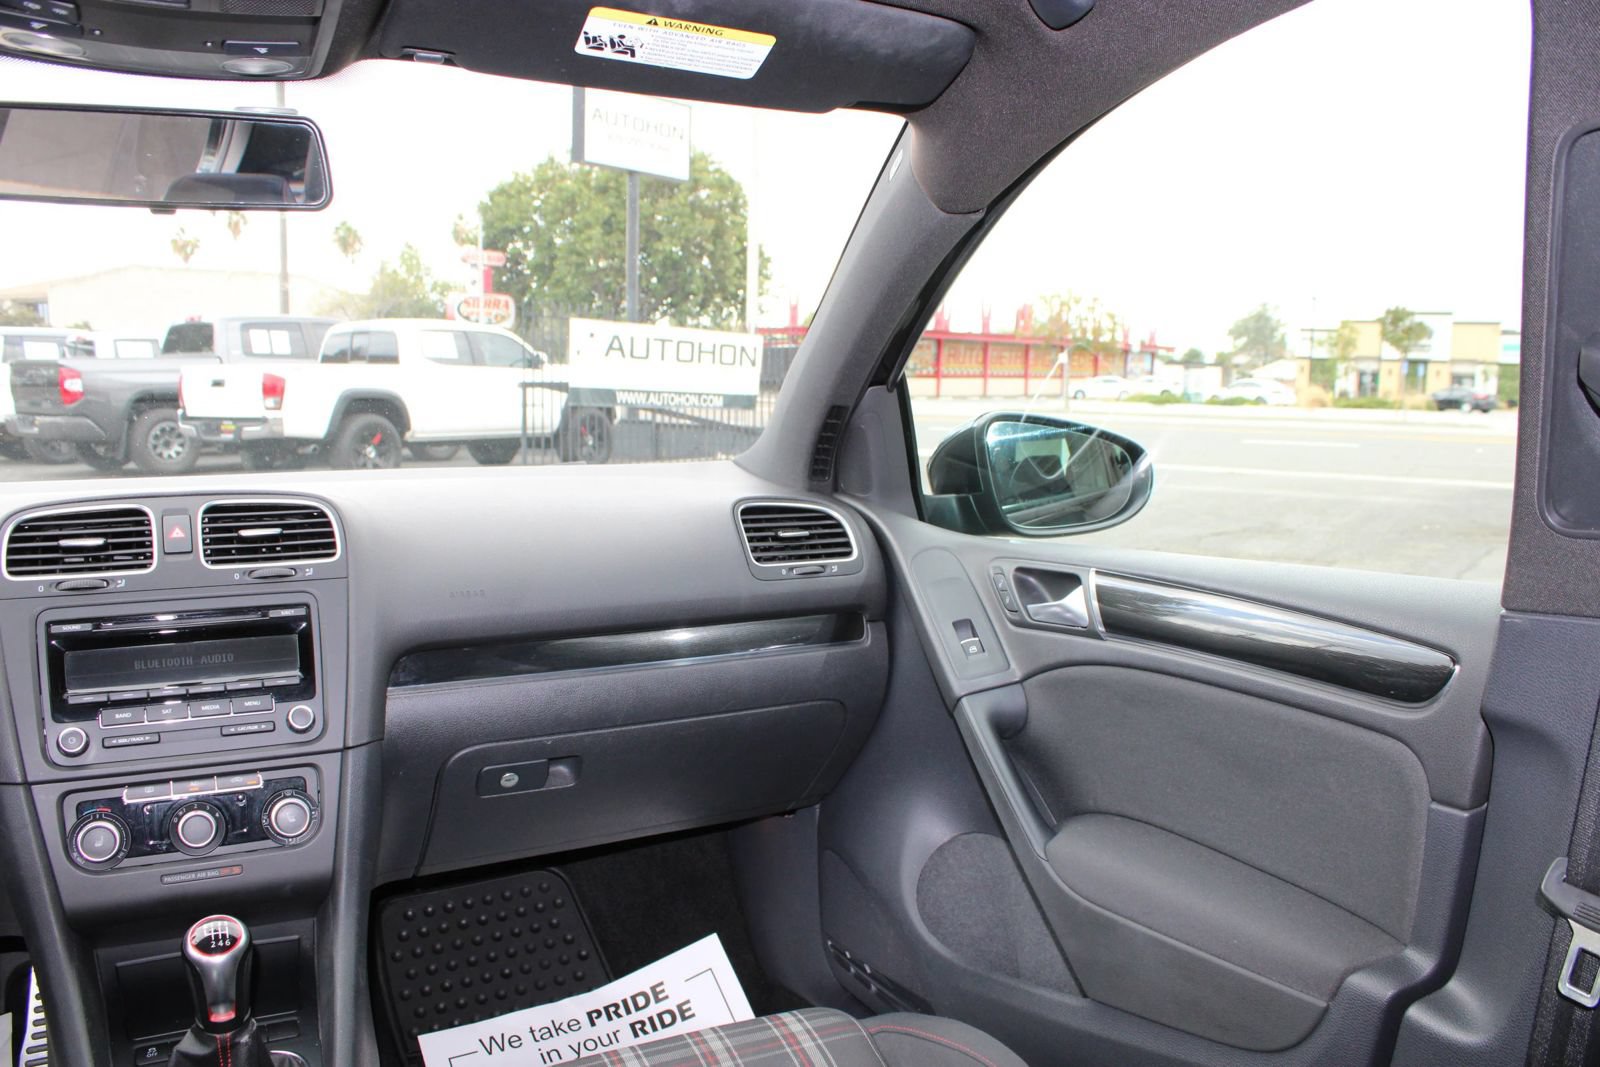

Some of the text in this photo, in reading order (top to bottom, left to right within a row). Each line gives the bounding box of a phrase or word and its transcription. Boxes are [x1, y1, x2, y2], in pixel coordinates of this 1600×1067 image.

[664, 21, 725, 36] WARNING
[592, 107, 684, 141] AUTOHON
[605, 335, 757, 367] AUTOHON
[616, 390, 724, 407] WWW.AUTOHON.COM
[201, 653, 235, 666] AUDIO
[478, 981, 670, 1056] We take PRIDE
[538, 999, 696, 1065] in your RIDE
